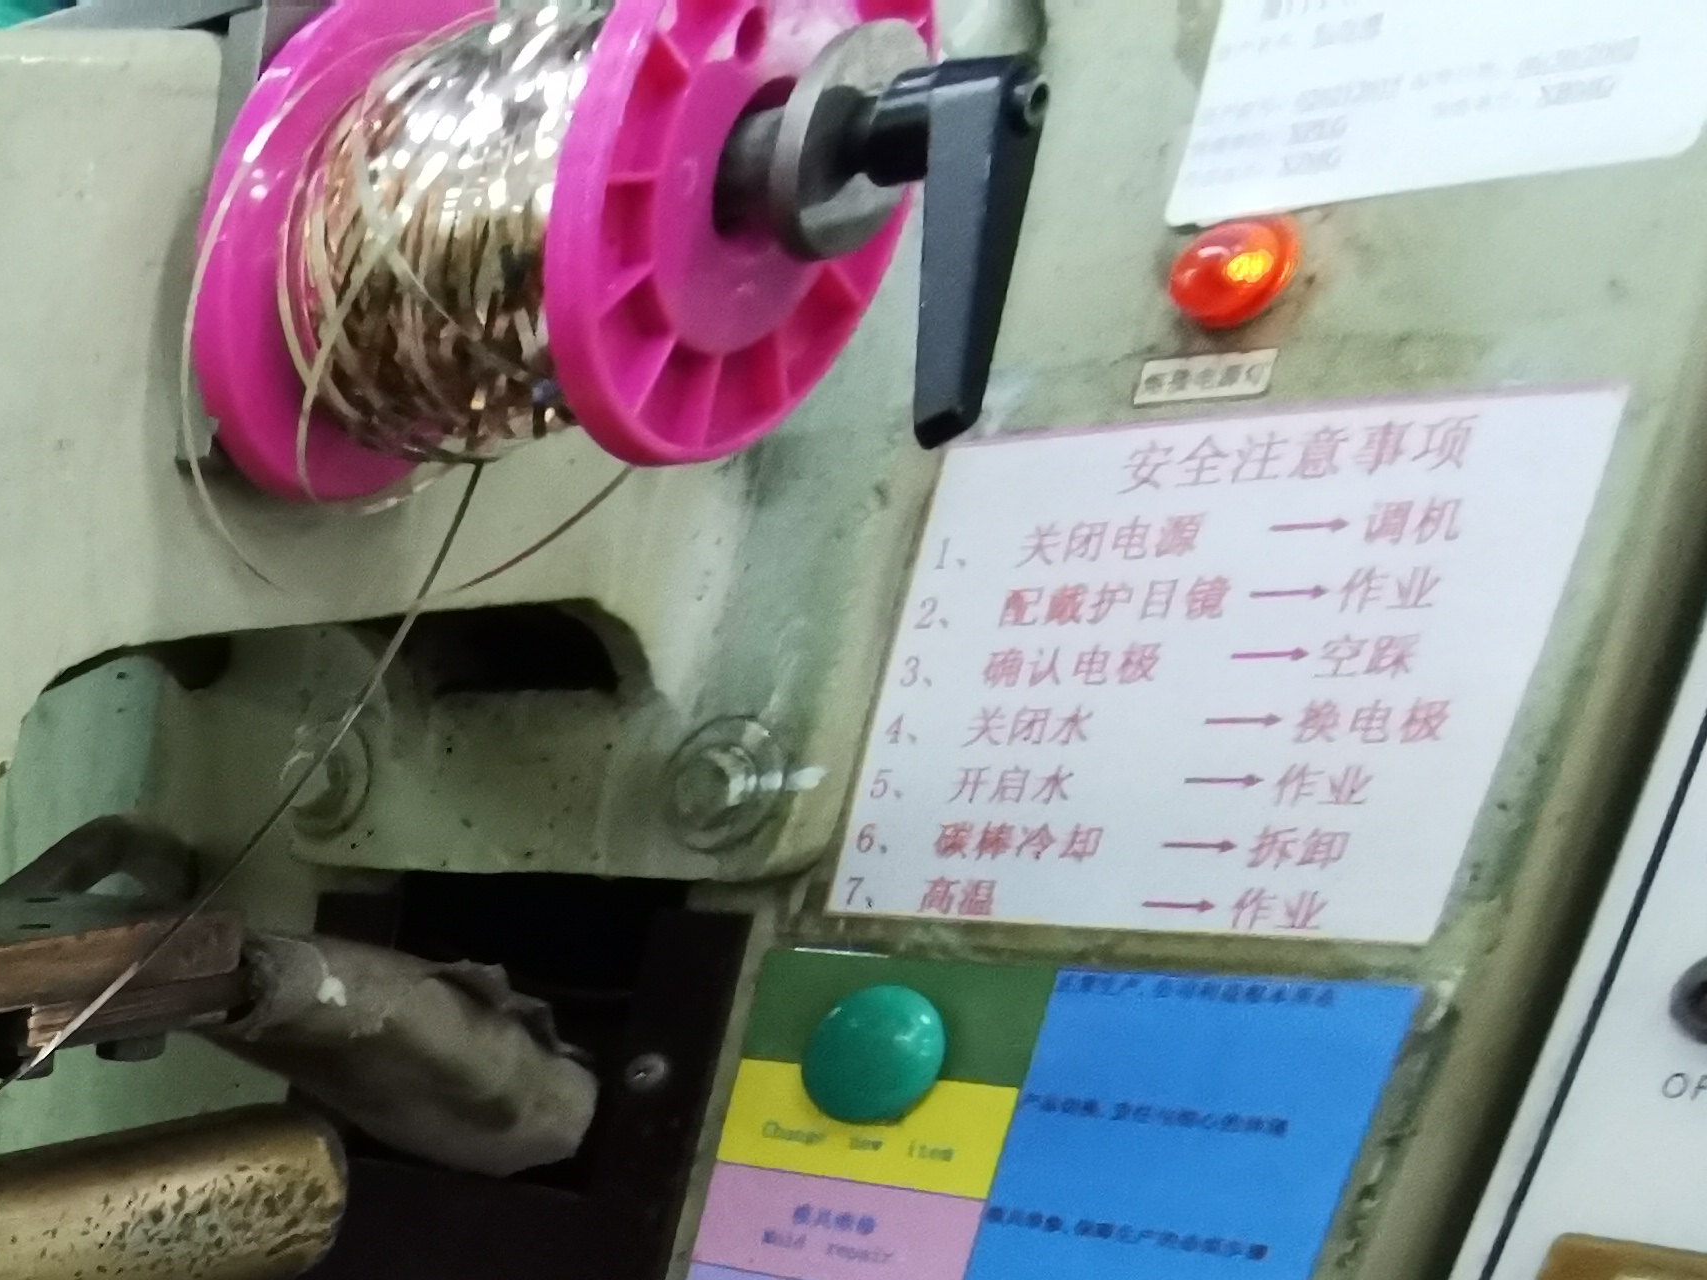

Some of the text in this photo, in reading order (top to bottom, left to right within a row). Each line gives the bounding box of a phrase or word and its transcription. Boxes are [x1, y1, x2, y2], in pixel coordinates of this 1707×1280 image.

[1116, 414, 1480, 495] 安全注意事项
[1014, 511, 1208, 568] 关闭电源
[1363, 497, 1465, 545] 调机
[1338, 565, 1441, 614] 作业
[982, 642, 1162, 688] 确认电极
[1312, 633, 1421, 679] 空踩
[960, 704, 1094, 748] 关闭水
[1292, 696, 1451, 744] 换电极
[947, 764, 1075, 804] 开启水
[1274, 762, 1374, 806] 作业
[933, 820, 1105, 862] 碳棒冷却
[1246, 825, 1352, 871] 拆卸
[917, 874, 998, 916] 高温
[1231, 886, 1329, 931] 作业
